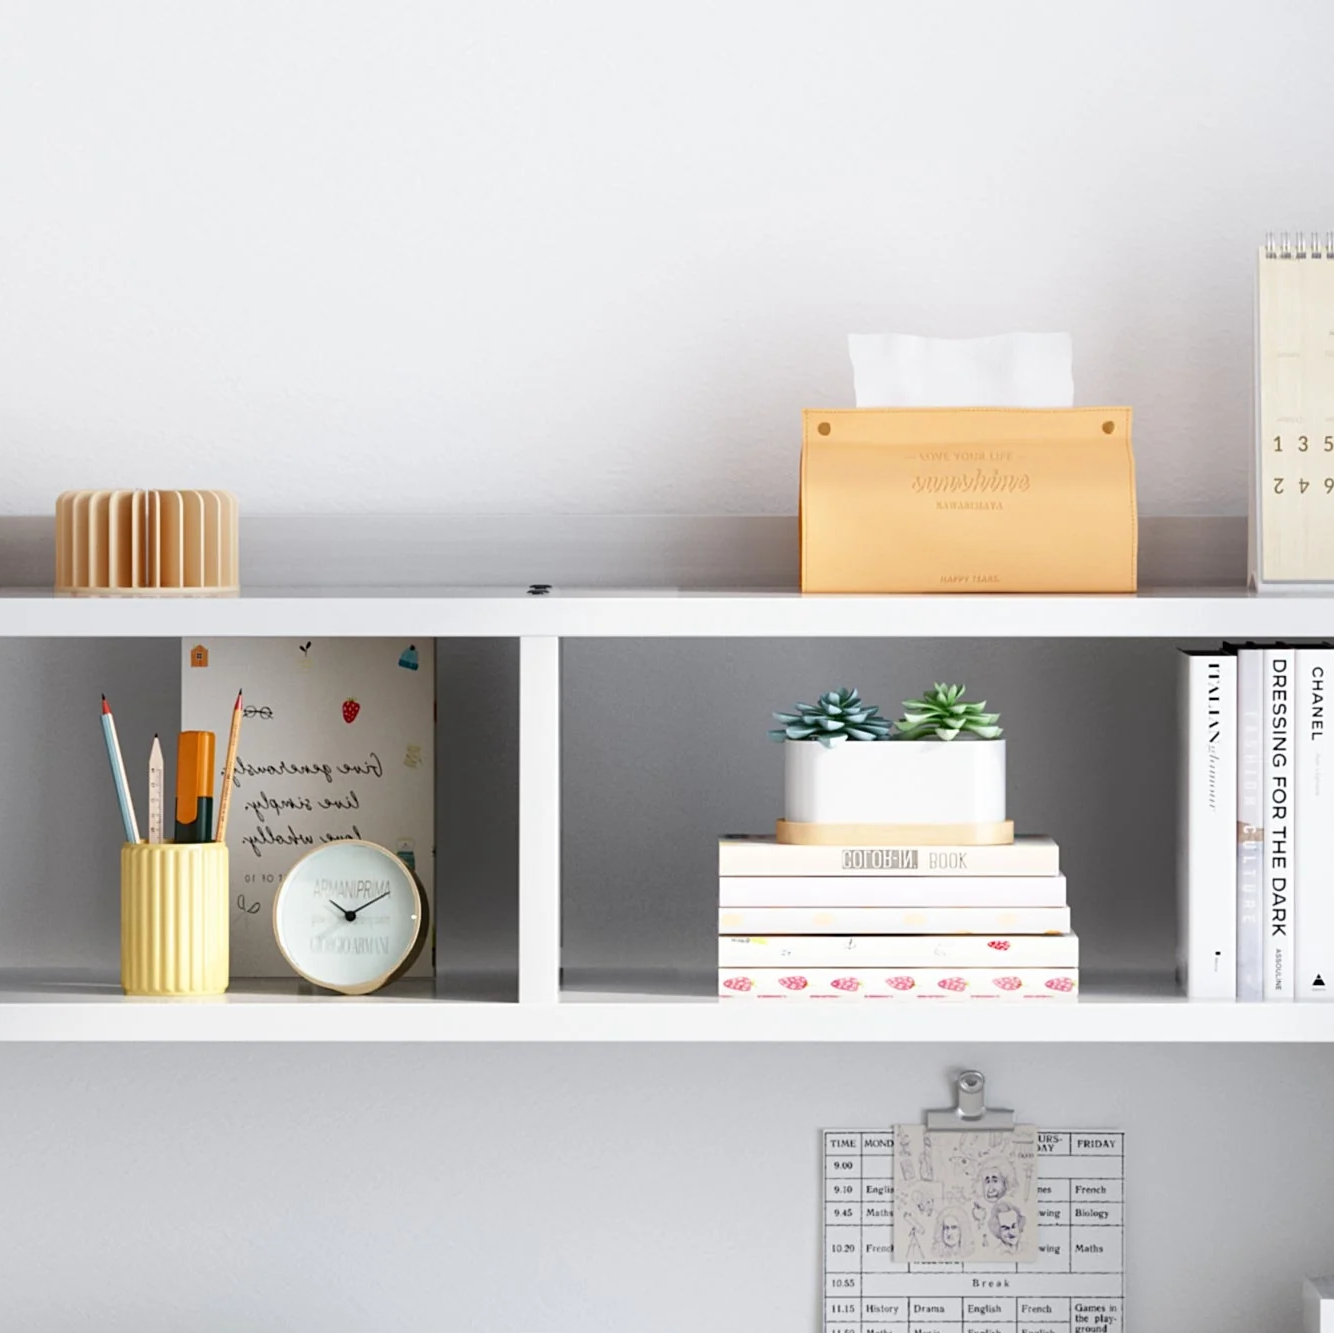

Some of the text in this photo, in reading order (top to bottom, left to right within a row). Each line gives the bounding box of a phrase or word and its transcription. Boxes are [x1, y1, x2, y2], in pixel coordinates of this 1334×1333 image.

[1274, 436, 1282, 452] 1
[1299, 436, 1308, 452] 3
[1324, 436, 1333, 452] 5
[1312, 667, 1323, 740] CHANEL
[1272, 660, 1286, 936] DRESSING FOR THE DARK
[1243, 826, 1258, 923] CULTURE
[830, 1140, 857, 1148] TIME
[1077, 1140, 1116, 1149] FRIDAY
[1075, 1185, 1107, 1194] French
[1075, 1209, 1109, 1220] Biology
[1075, 1244, 1103, 1253] Maths
[972, 1279, 1010, 1288] Break
[832, 1305, 855, 1313] 11.15
[866, 1304, 899, 1315] History
[914, 1305, 945, 1313] Drama
[968, 1304, 1002, 1315] English
[1022, 1304, 1052, 1313] French
[1075, 1304, 1117, 1313] Games in
[1075, 1314, 1117, 1325] the play-
